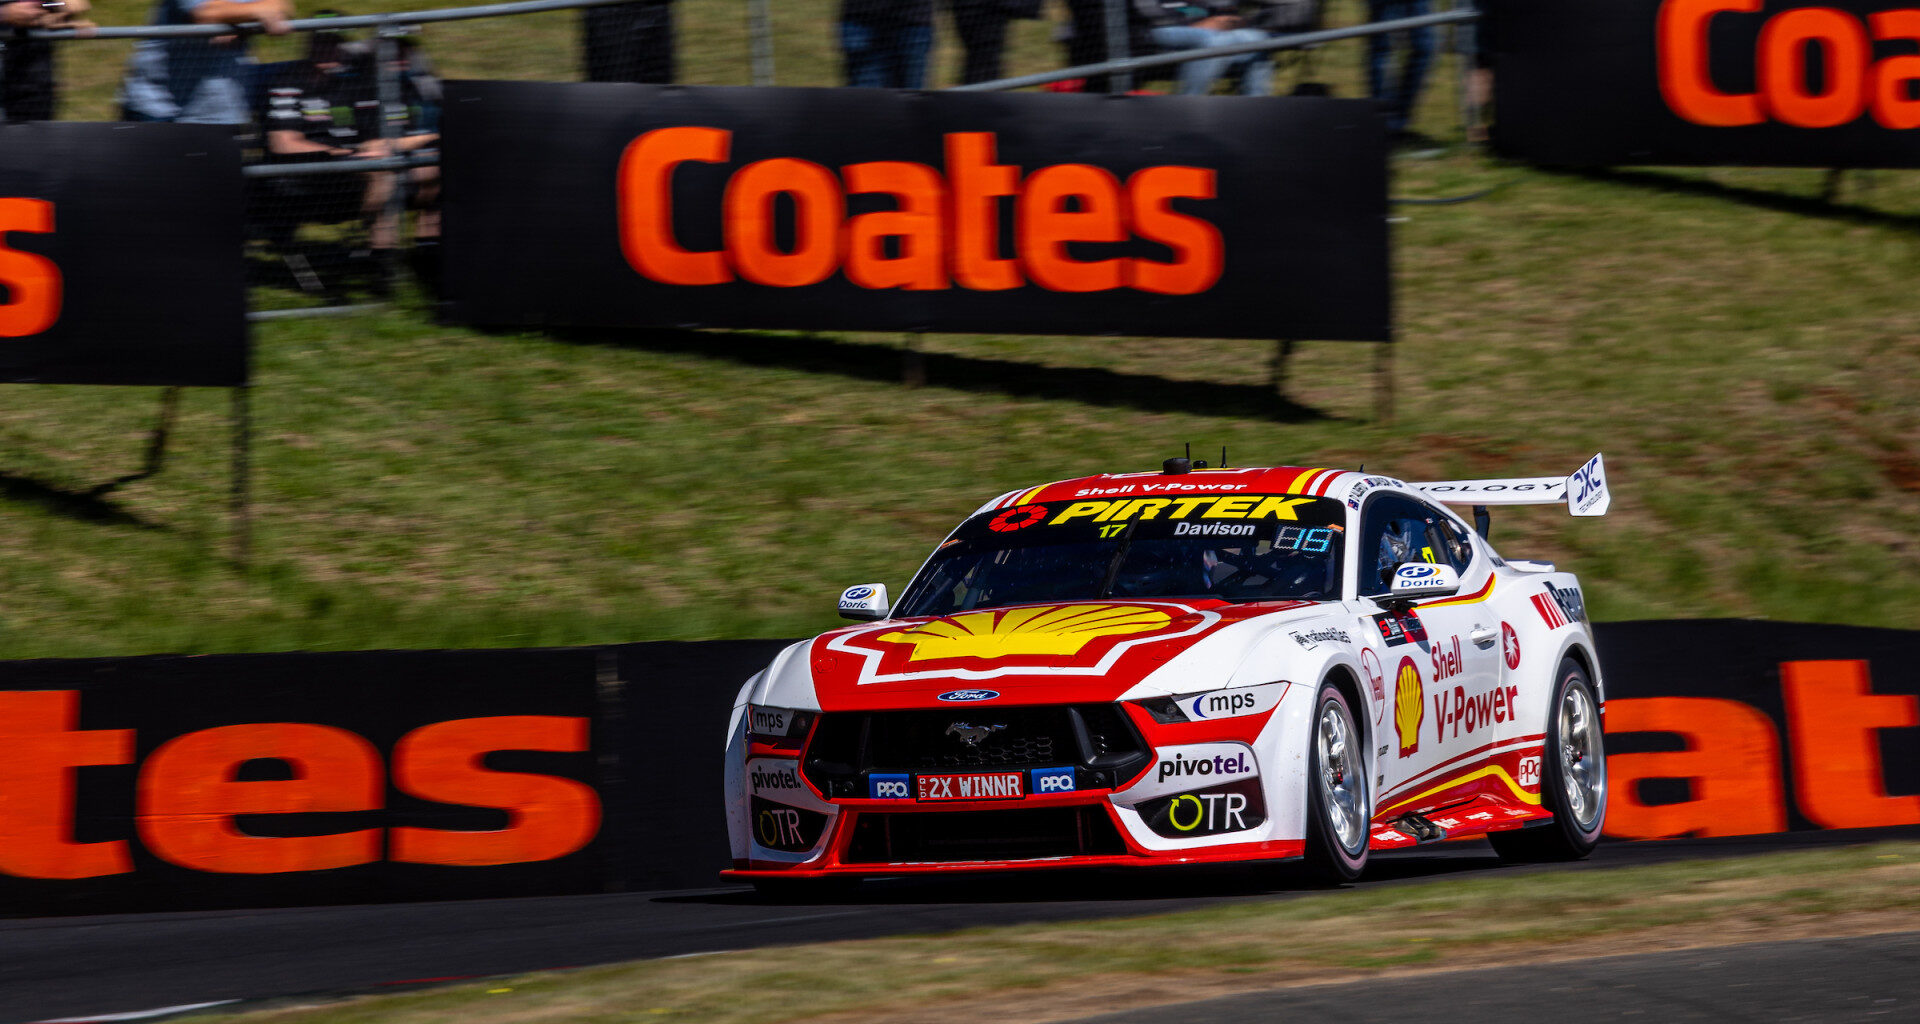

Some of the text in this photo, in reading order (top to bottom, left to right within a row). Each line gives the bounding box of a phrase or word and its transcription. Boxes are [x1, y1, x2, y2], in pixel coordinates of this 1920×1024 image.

[617, 126, 1225, 295] Coates
[1075, 483, 1247, 497] Shell V-Power
[1419, 482, 1563, 492] OLOGY
[1574, 457, 1601, 503] DXC
[1048, 496, 1317, 526] PIRTEK
[1099, 523, 1128, 539] 17
[1173, 521, 1256, 537] Davison
[1401, 577, 1444, 588] Doric
[839, 600, 867, 609] Doric
[1431, 634, 1462, 683] Shell
[948, 689, 989, 700] Ford
[1209, 692, 1255, 715] mps
[756, 711, 784, 732] mps
[1433, 685, 1518, 744] V-Power
[1158, 752, 1250, 783] pivotel.
[0, 689, 602, 880] tes
[877, 781, 908, 797] PPQ
[929, 774, 1021, 798] 2X WINNR
[1040, 774, 1074, 792] PPQ
[1169, 793, 1247, 831] OTR
[759, 809, 804, 846] OTR
